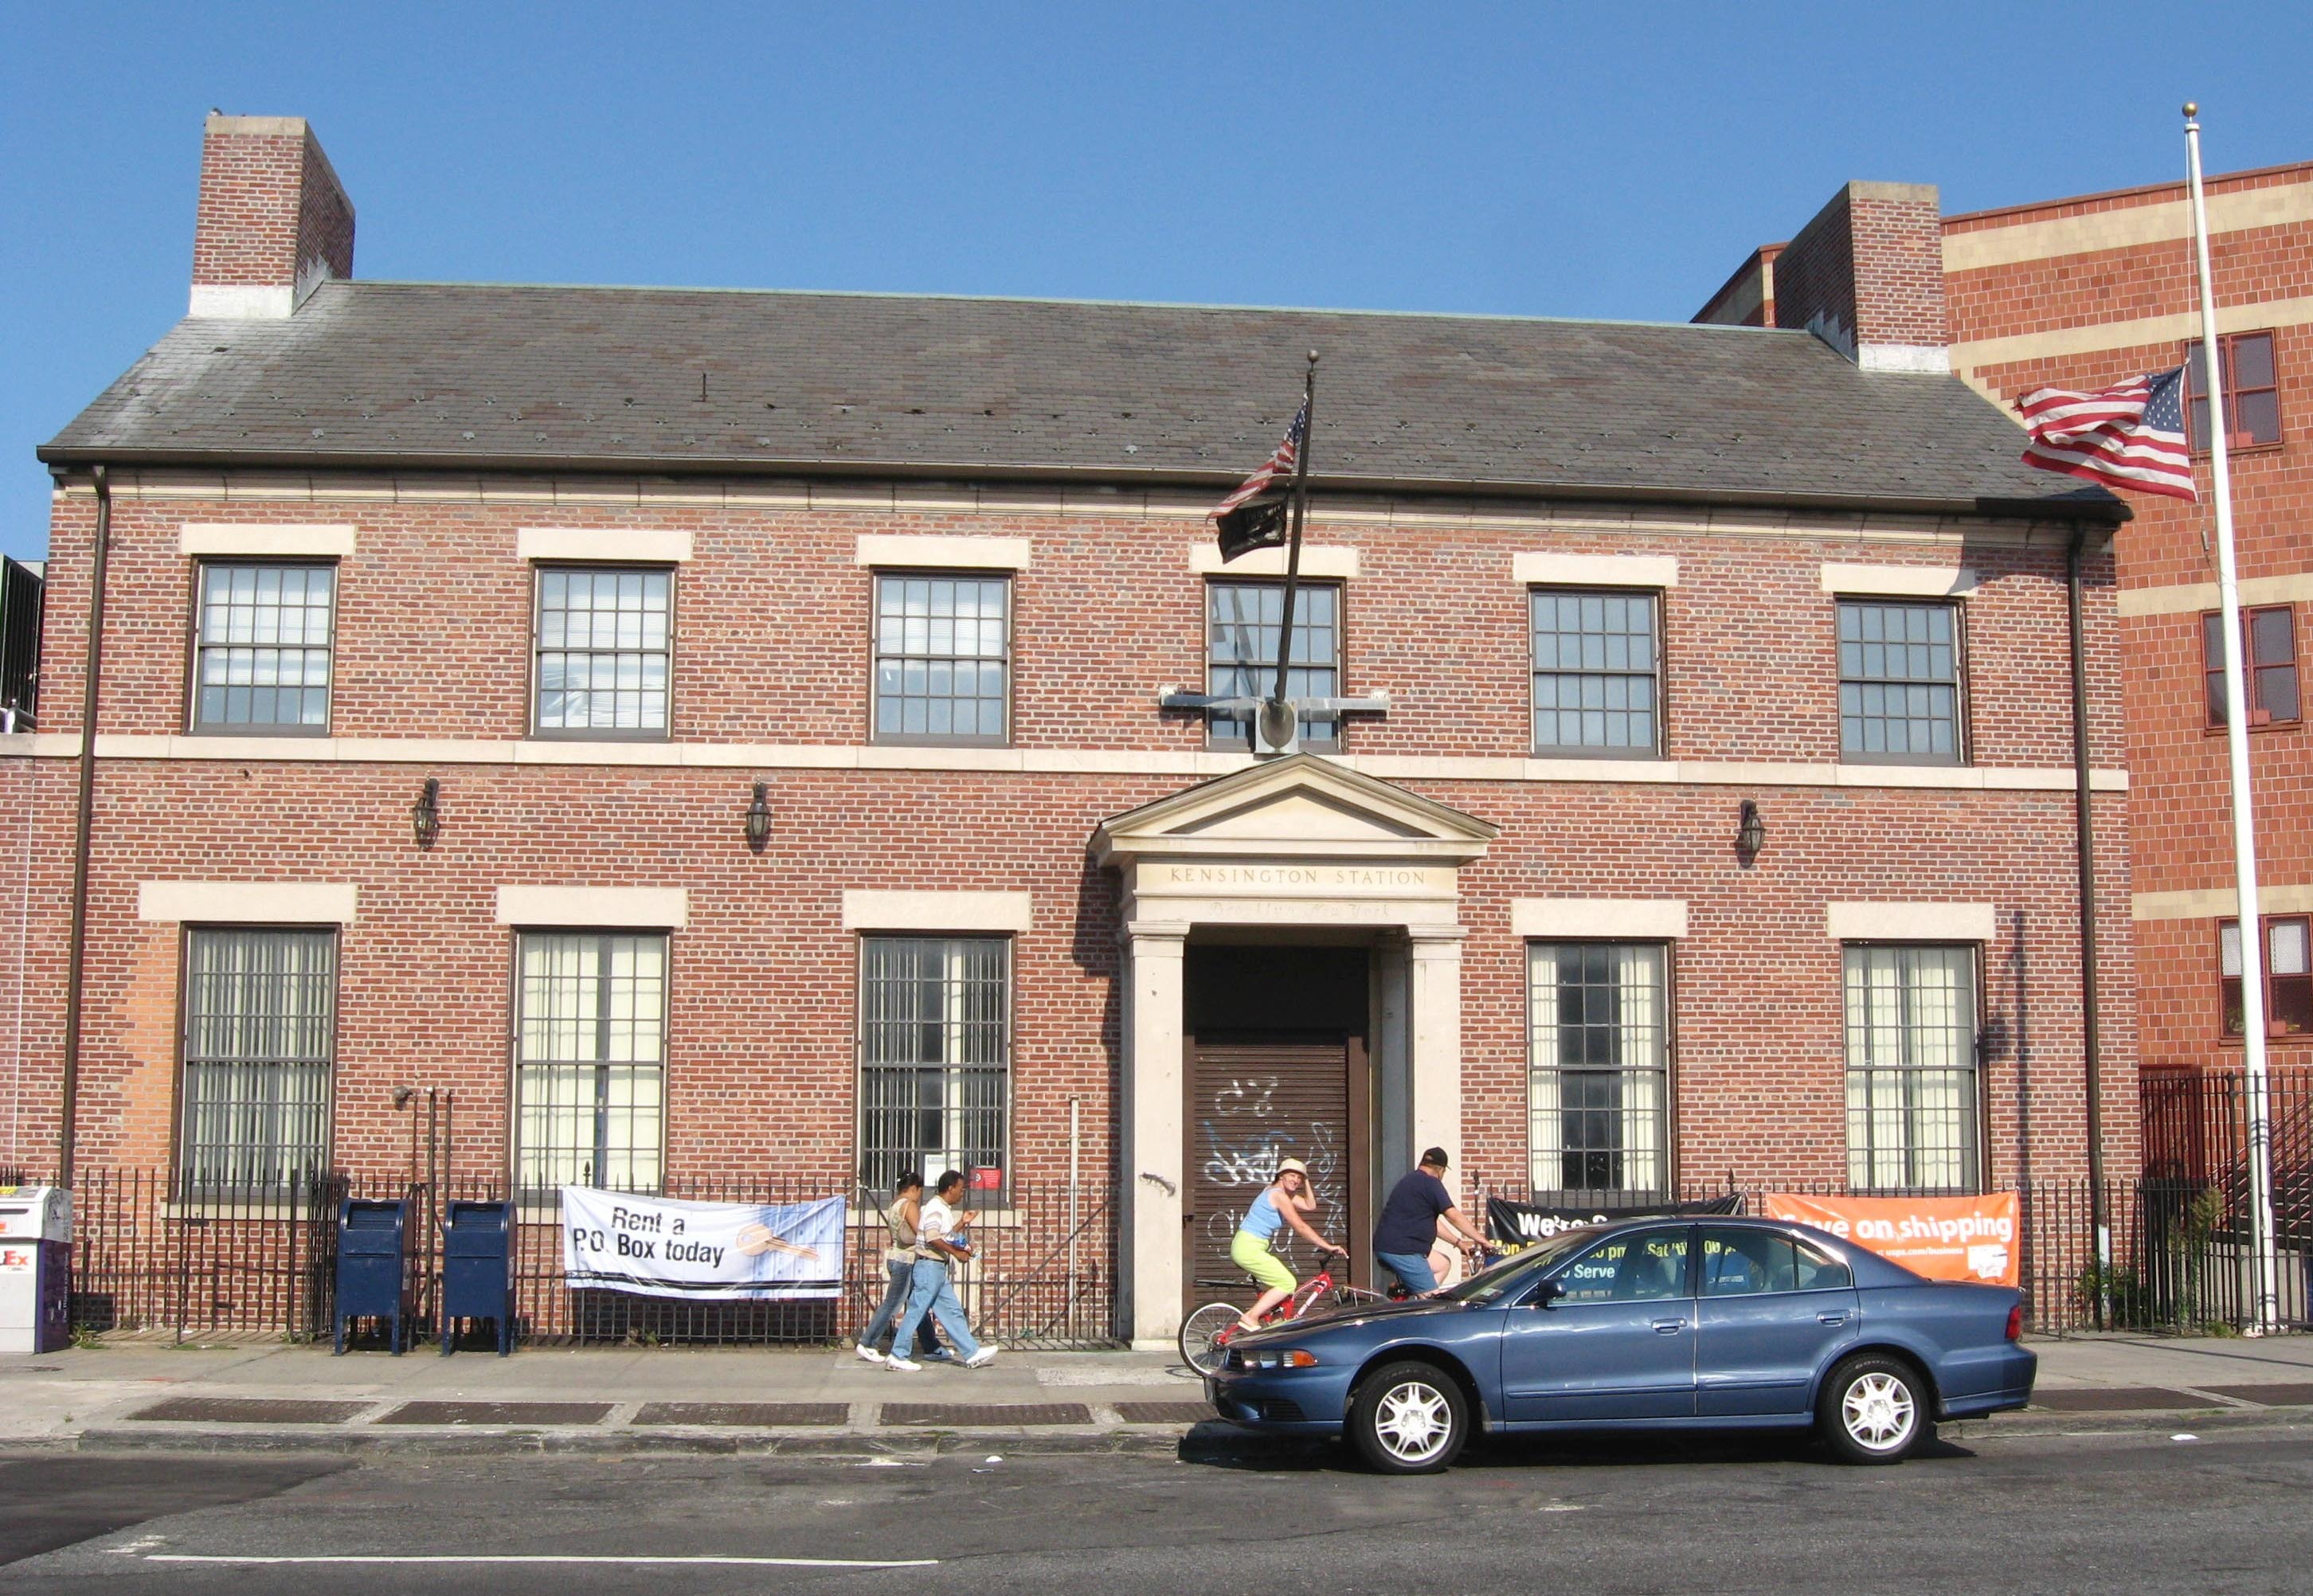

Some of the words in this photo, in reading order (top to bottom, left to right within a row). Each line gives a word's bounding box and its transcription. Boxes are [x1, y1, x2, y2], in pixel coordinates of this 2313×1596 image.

[1170, 867, 1317, 884] KENSINGTON
[1336, 870, 1427, 885] STATION
[611, 1207, 662, 1233] Rent
[672, 1218, 685, 1234] a
[1855, 1219, 1894, 1238] on
[1899, 1211, 2013, 1242] shipping
[617, 1234, 656, 1259] Box
[665, 1239, 725, 1269] today
[1573, 1263, 1616, 1279] Serve
